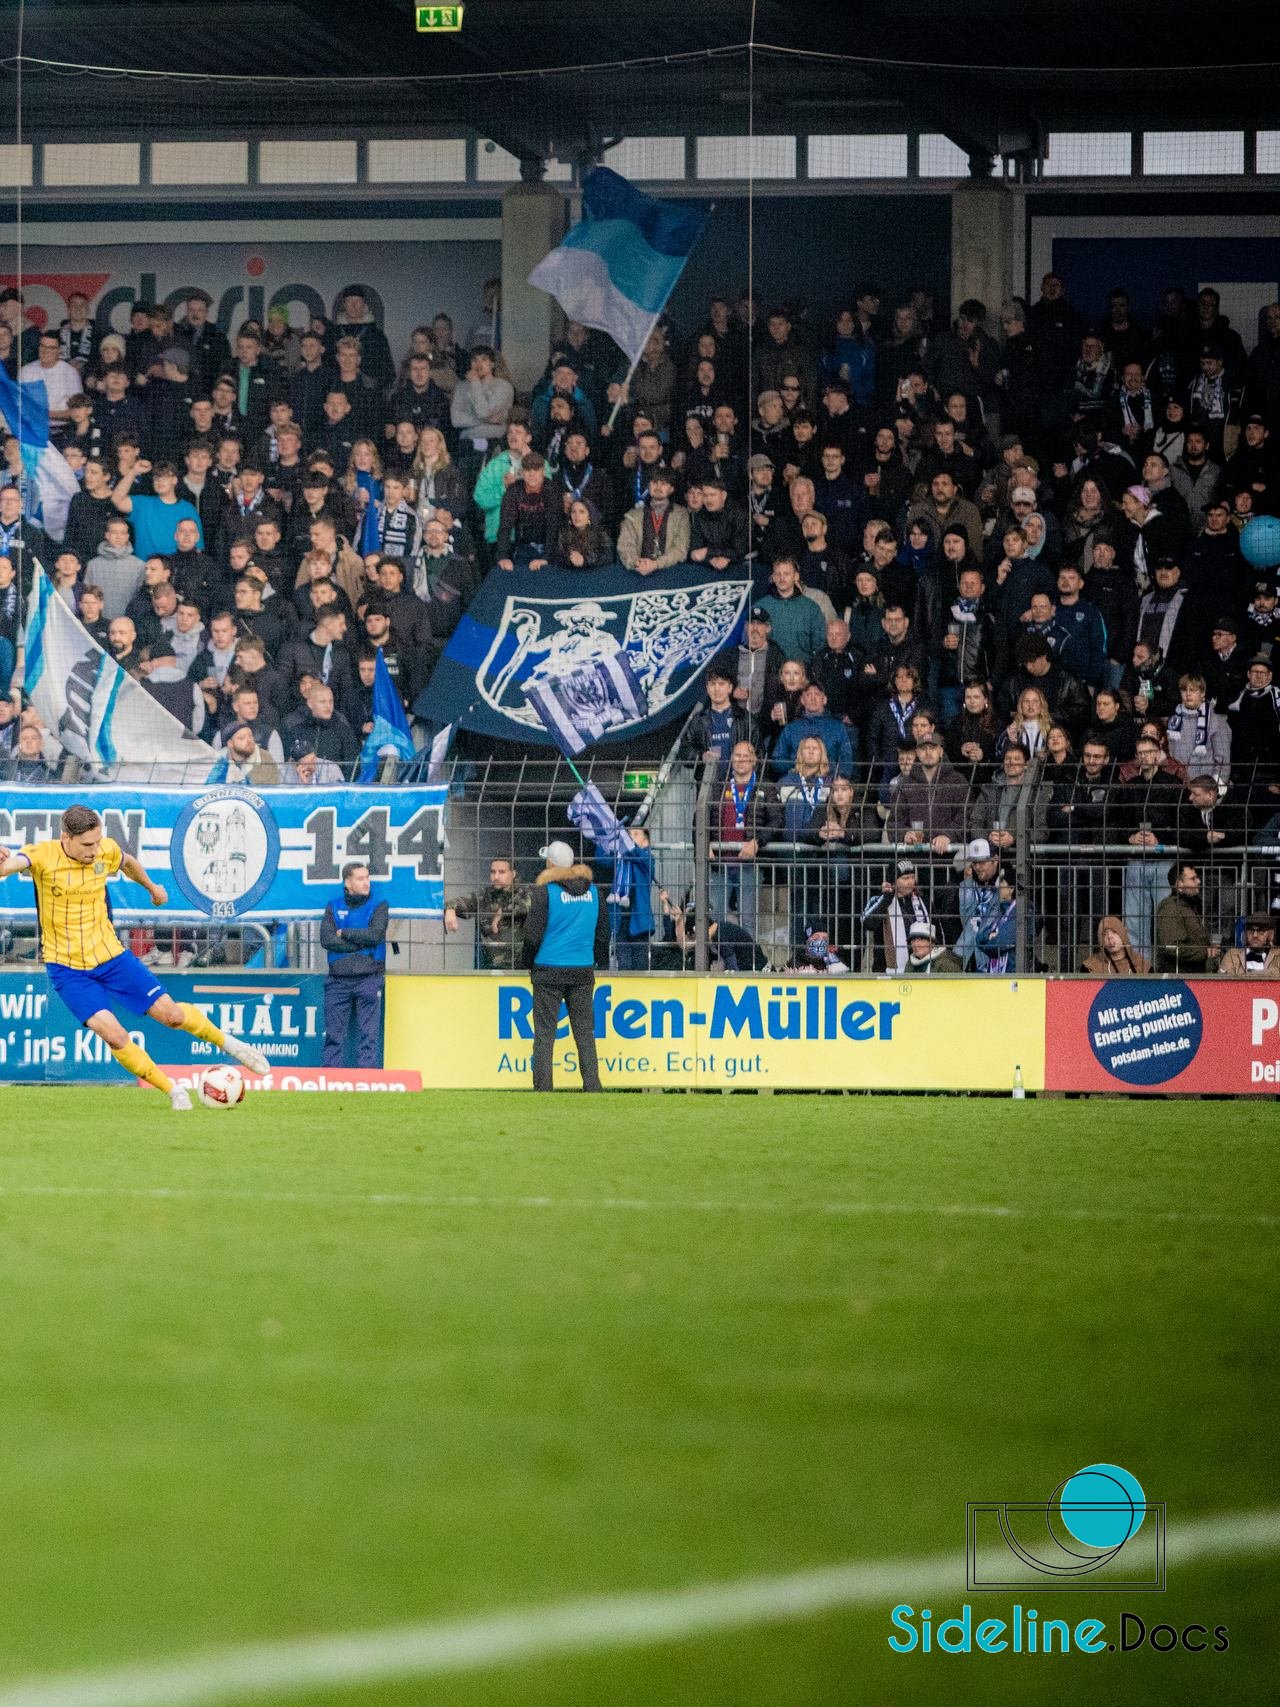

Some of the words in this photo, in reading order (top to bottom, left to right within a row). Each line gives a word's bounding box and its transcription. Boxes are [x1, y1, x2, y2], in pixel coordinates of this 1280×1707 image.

[304, 804, 446, 881] 144
[213, 902, 235, 916] 144
[0, 985, 48, 1019] wir
[1097, 1008, 1120, 1028] Mit
[1120, 993, 1183, 1021] regionaler
[1093, 1023, 1142, 1048] Energie
[1142, 1010, 1197, 1038] punkten.
[1252, 998, 1280, 1047] P
[23, 1028, 67, 1063] ins
[191, 1041, 212, 1055] DAS
[1109, 1036, 1191, 1069] potsdam-liebe.de
[666, 1051, 716, 1073] Echt
[725, 1052, 770, 1079] gut.
